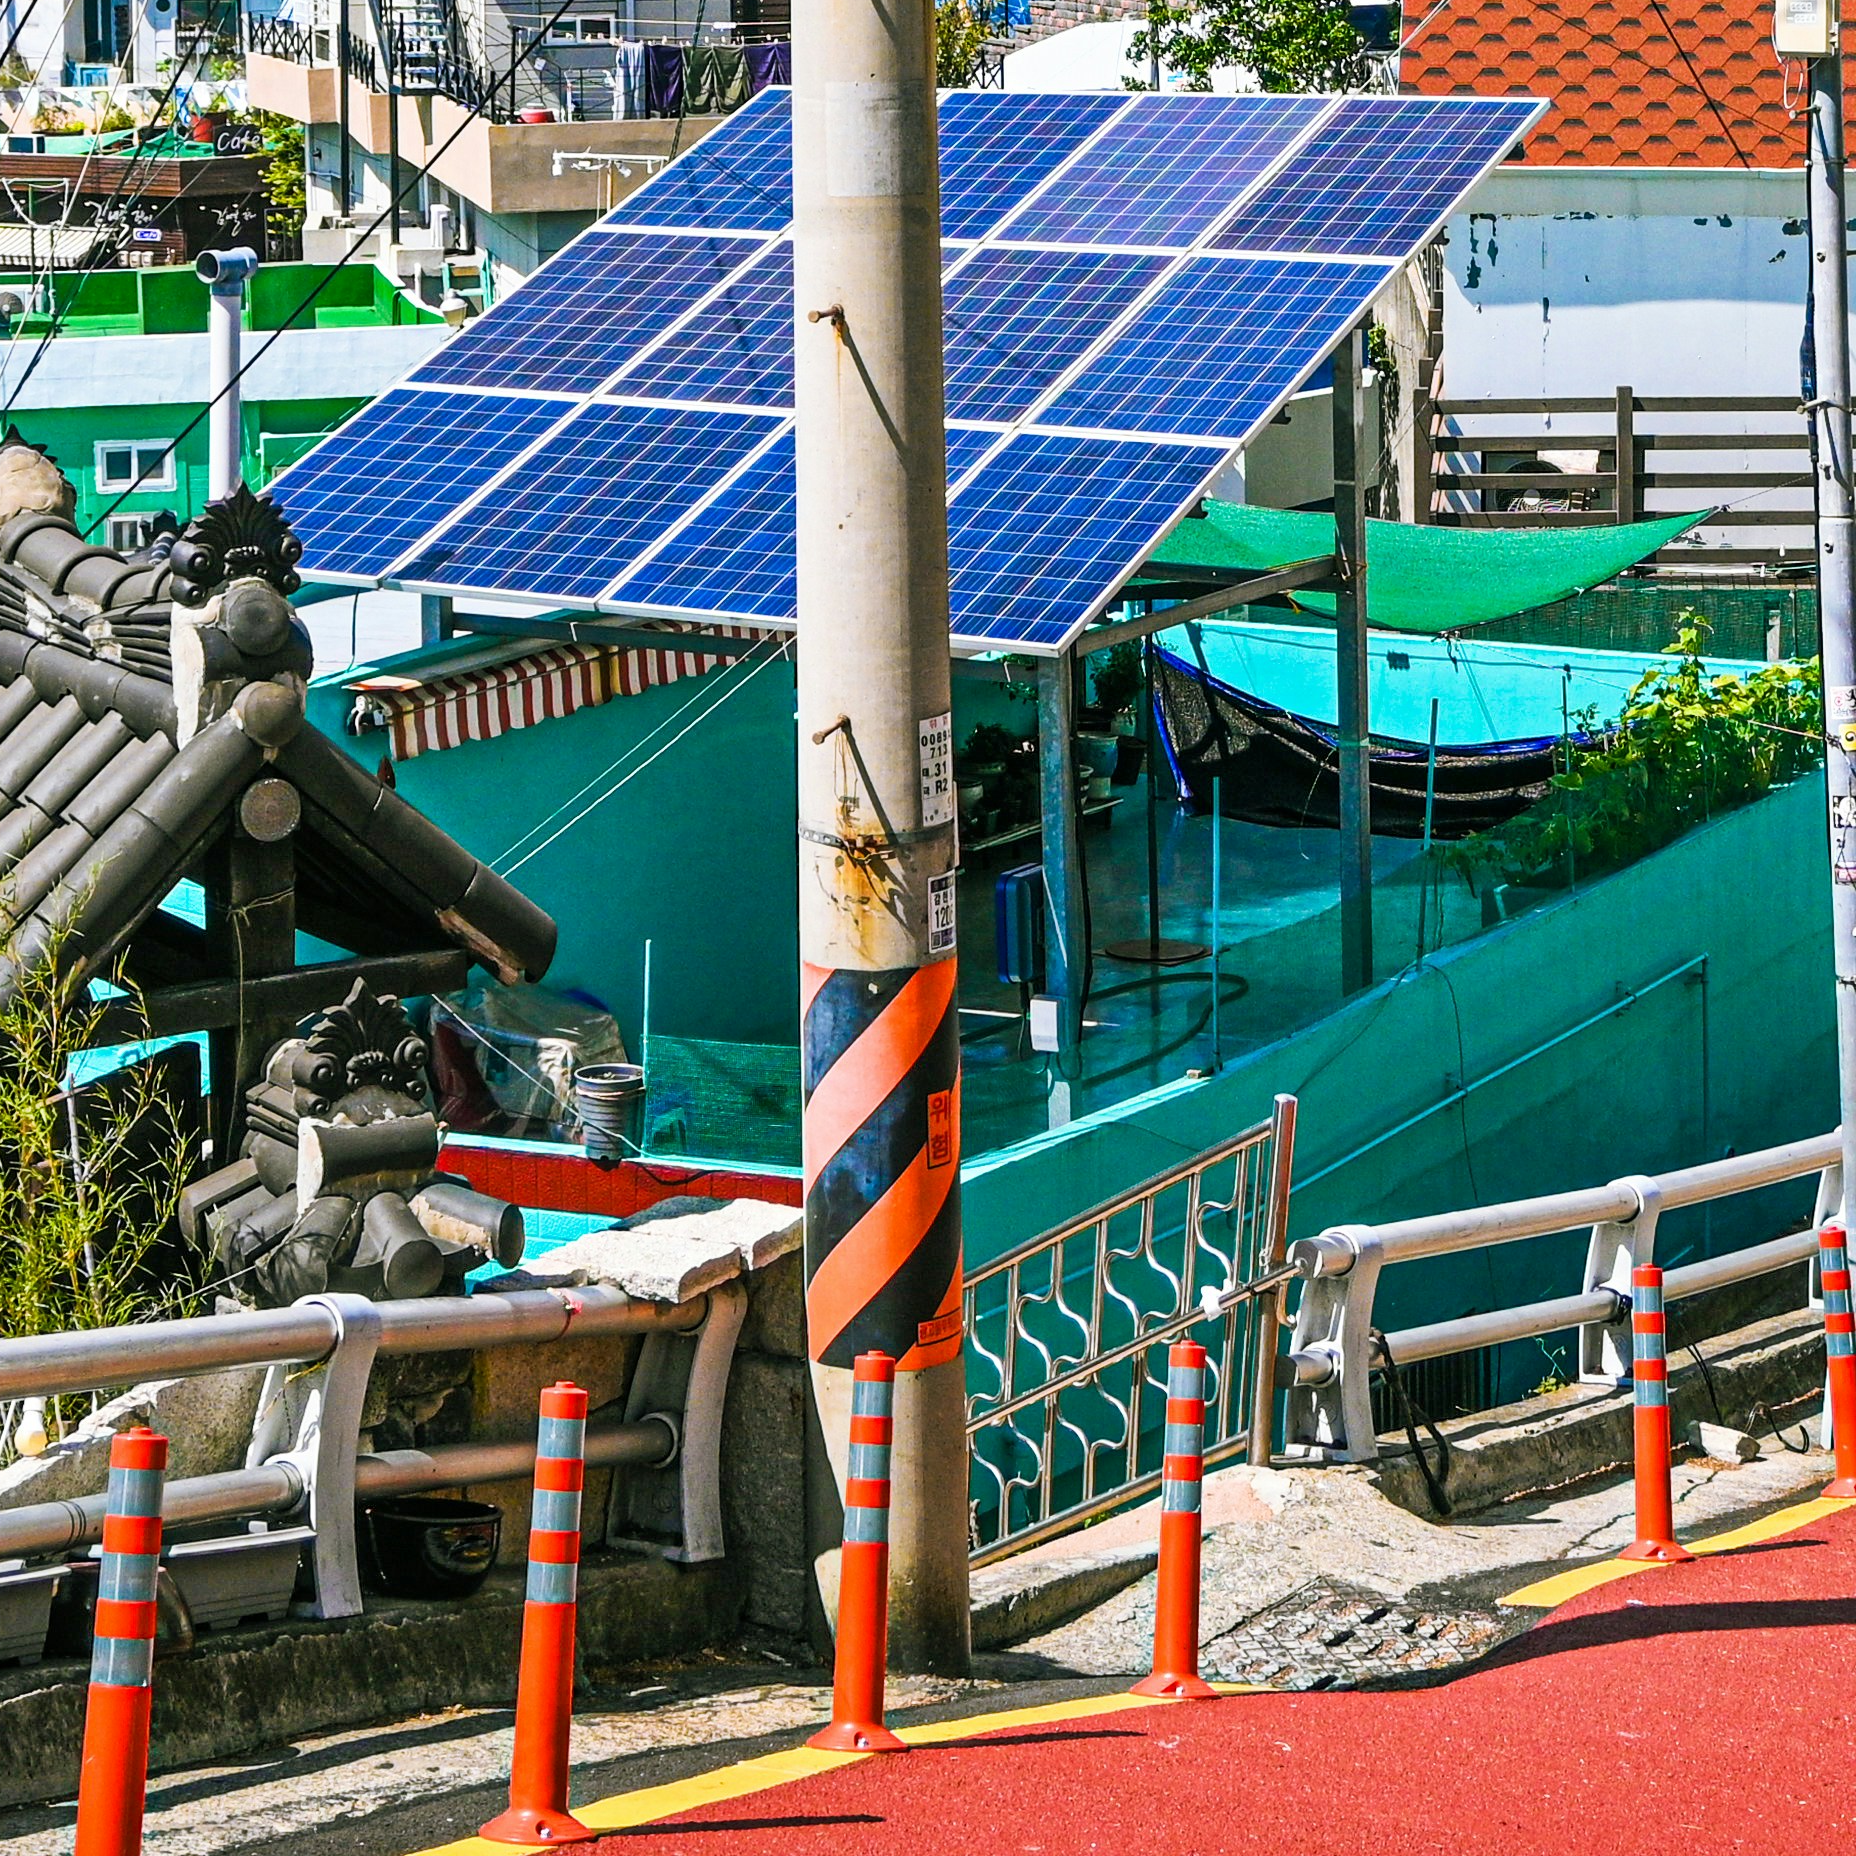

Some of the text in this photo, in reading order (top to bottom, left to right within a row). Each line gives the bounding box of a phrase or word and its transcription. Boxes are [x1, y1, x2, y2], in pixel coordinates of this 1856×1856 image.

[930, 743, 948, 759] 713
[935, 760, 947, 778] 31
[935, 778, 948, 795] R2
[930, 1095, 948, 1160] 위험
